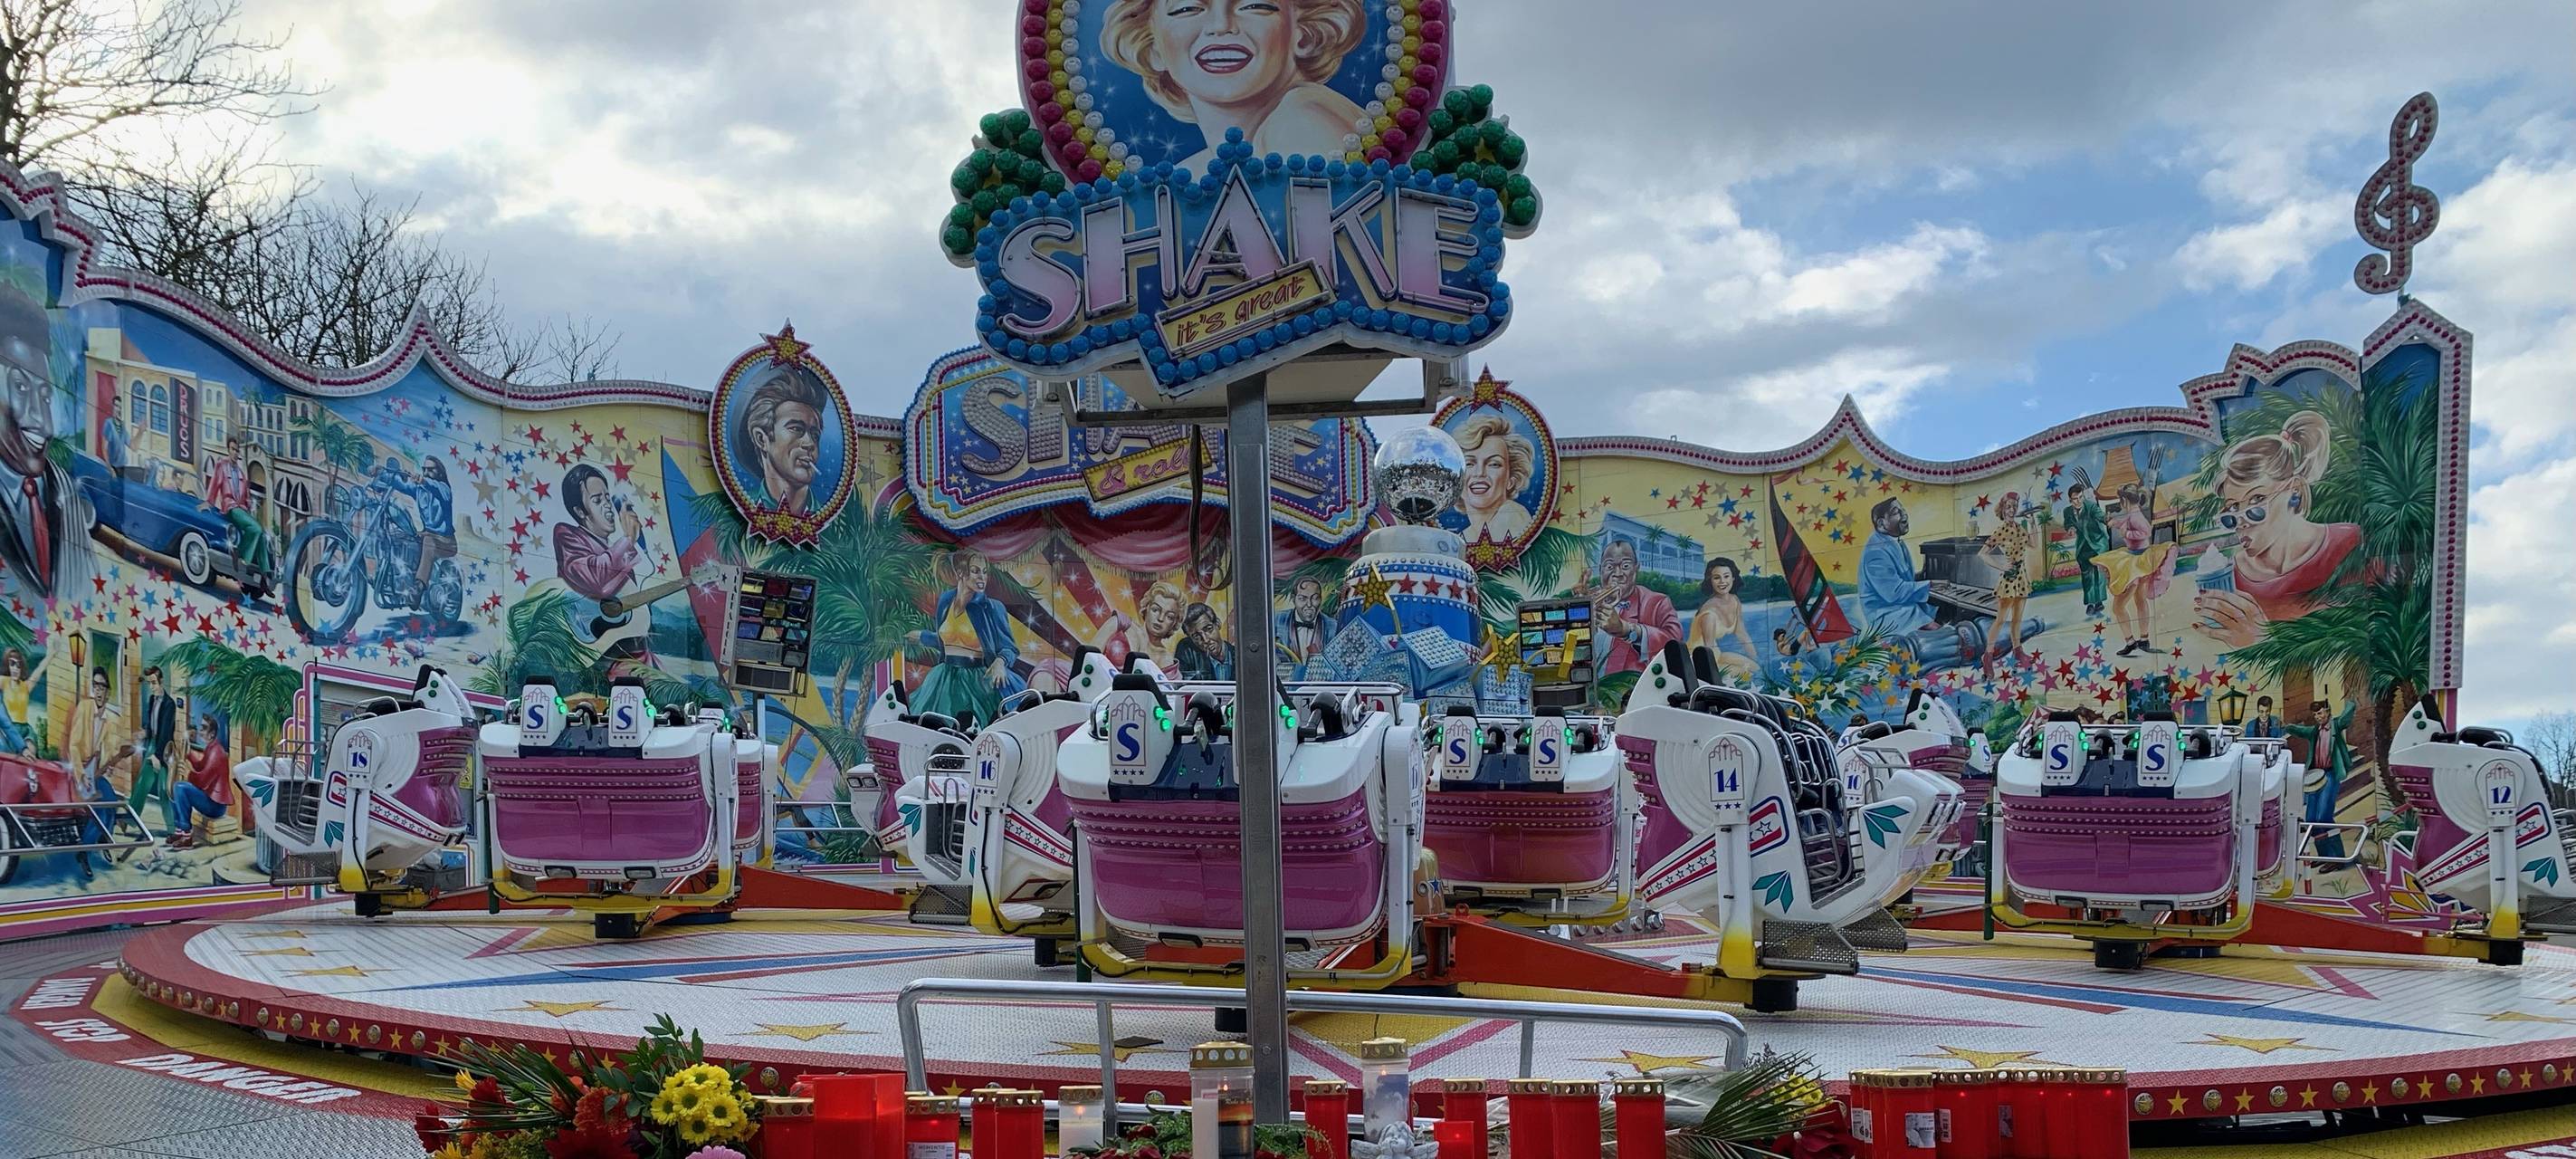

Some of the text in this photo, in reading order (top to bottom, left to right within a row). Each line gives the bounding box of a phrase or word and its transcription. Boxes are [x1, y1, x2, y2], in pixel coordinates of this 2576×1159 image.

[997, 163, 1489, 341] SHAKE
[1177, 275, 1305, 347] it's great
[179, 383, 189, 458] DRUGS
[526, 704, 545, 730] S
[615, 704, 634, 731] S
[1115, 723, 1140, 761] S
[1448, 738, 1467, 765] S
[1538, 738, 1557, 765] S
[979, 760, 997, 781] 16
[2049, 743, 2070, 771] S
[2145, 743, 2166, 771] S
[1713, 767, 1740, 793] 14
[2490, 785, 2513, 804] 12
[34, 1018, 131, 1043] STOP
[115, 1053, 362, 1105] DANGER
